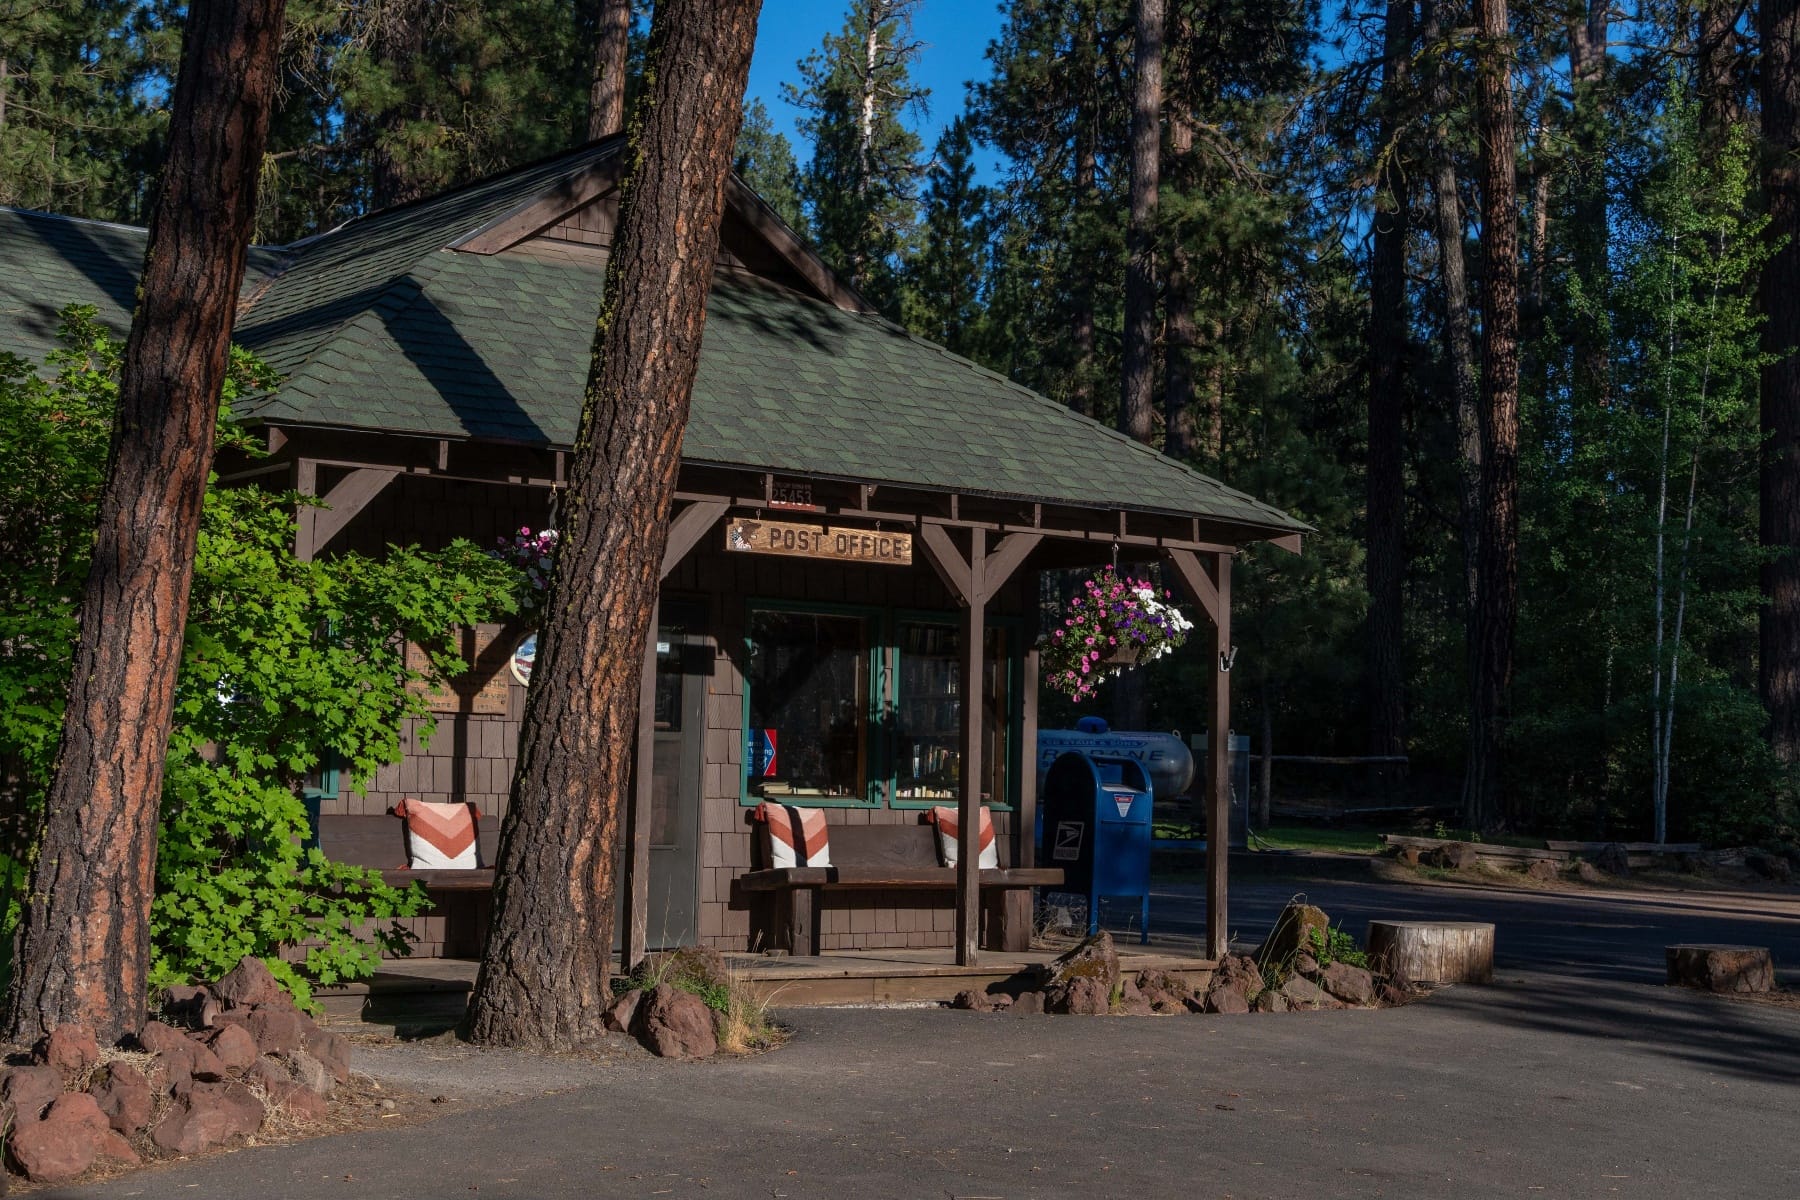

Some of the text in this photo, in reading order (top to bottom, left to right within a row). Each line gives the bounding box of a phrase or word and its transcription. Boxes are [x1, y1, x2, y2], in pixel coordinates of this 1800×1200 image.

[771, 488, 812, 506] 25453
[770, 527, 902, 558] POST OFFICE
